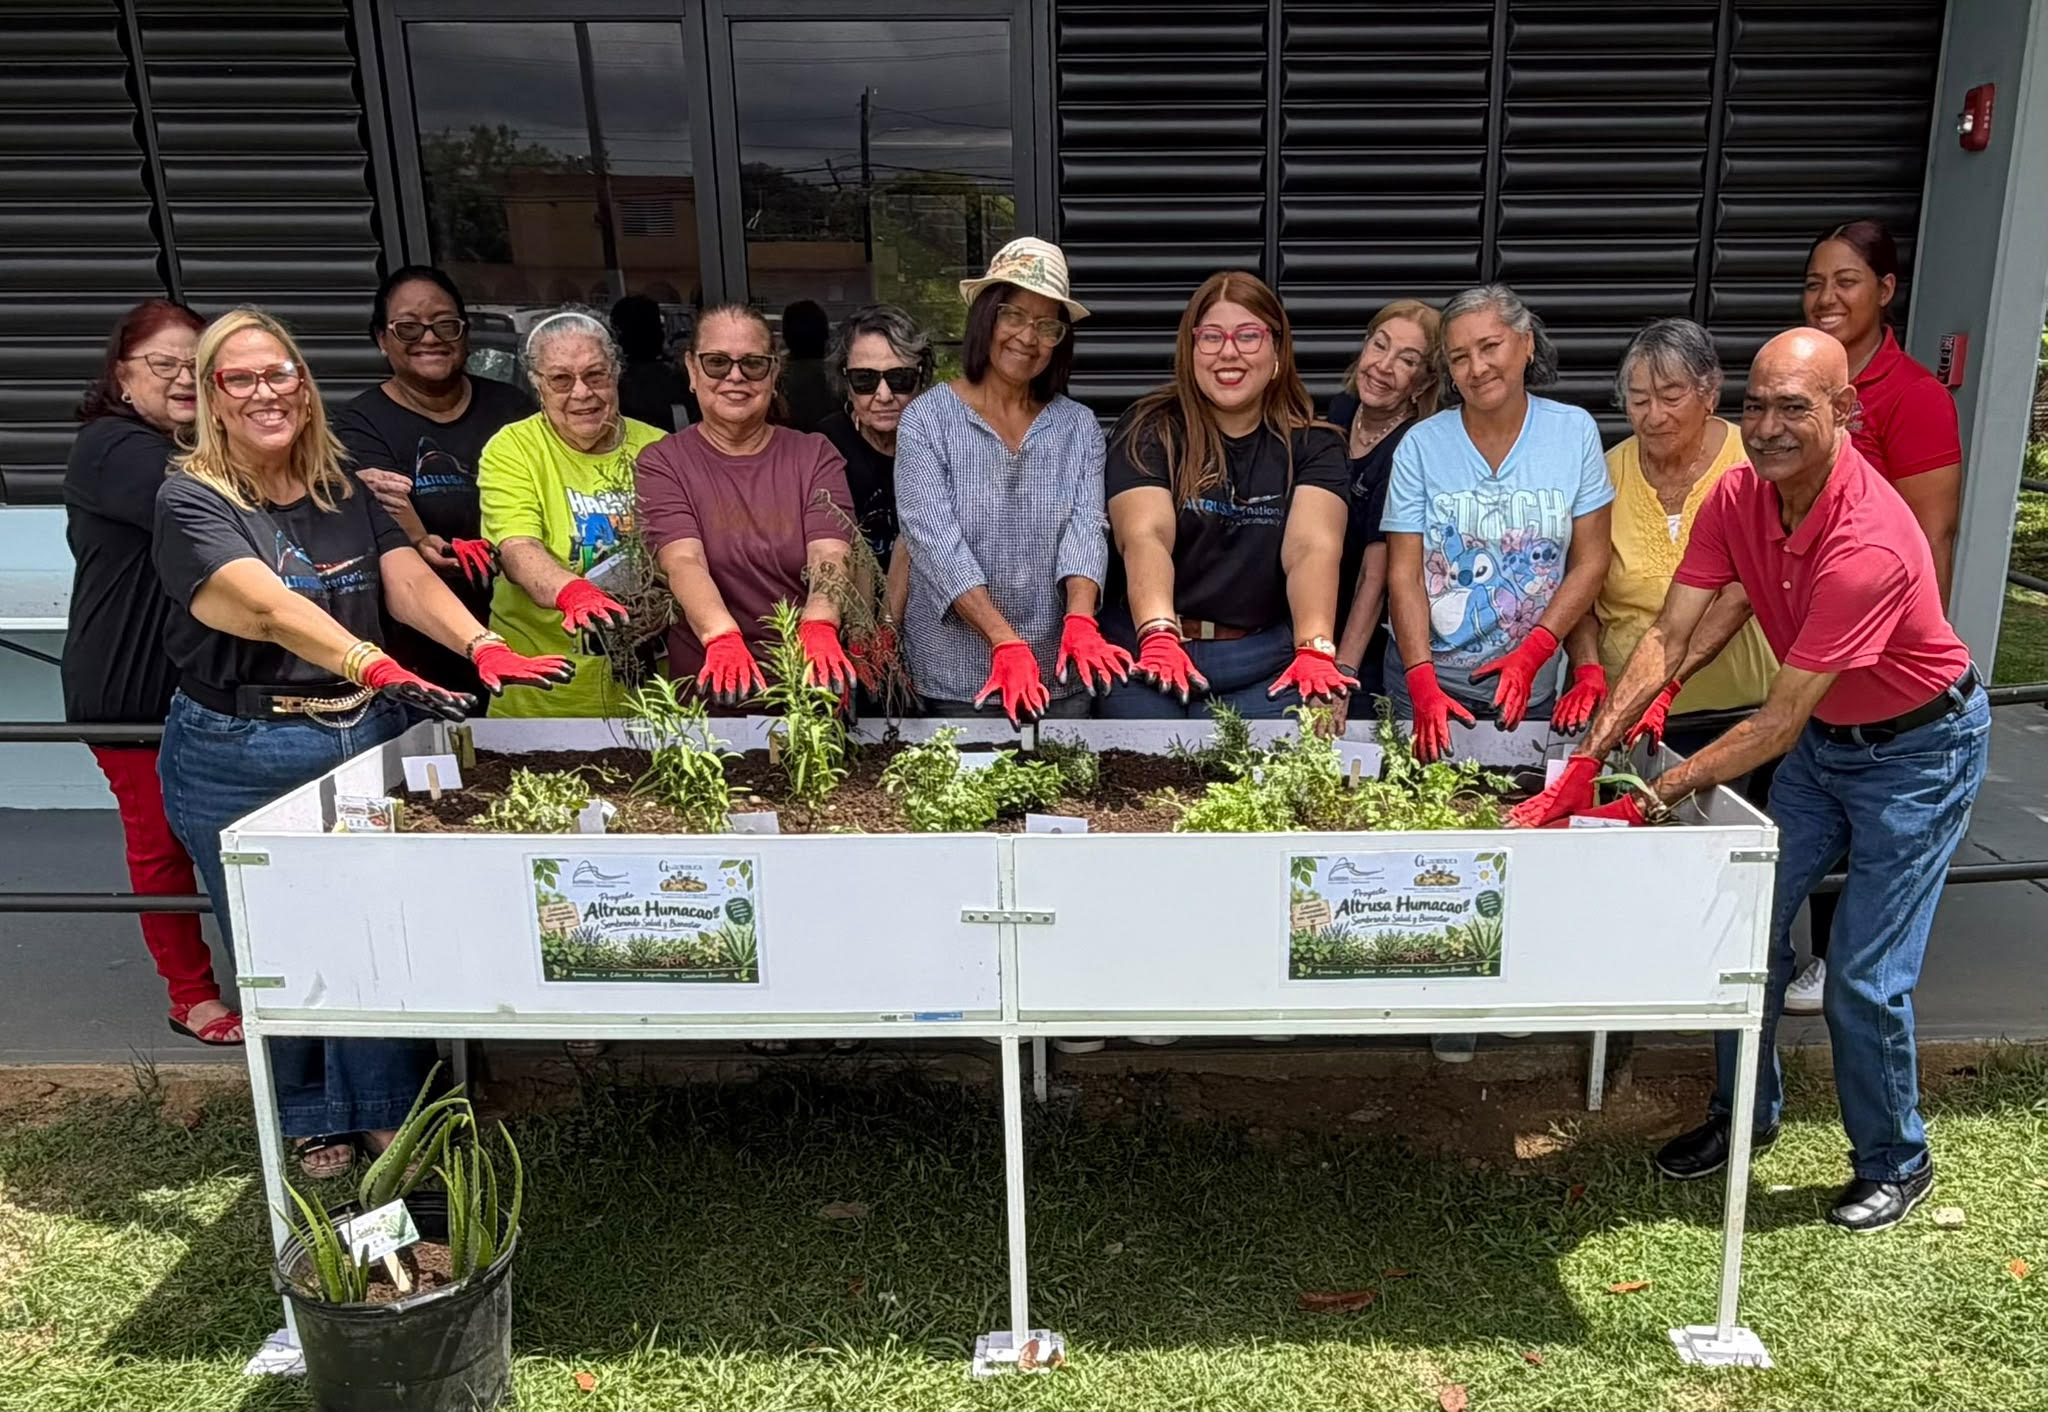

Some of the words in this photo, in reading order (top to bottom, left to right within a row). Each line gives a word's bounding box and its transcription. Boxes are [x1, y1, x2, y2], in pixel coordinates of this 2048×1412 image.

[598, 891, 634, 904] Proyecto
[1352, 887, 1388, 900] Proyecto
[583, 901, 641, 922] Altrusa
[645, 900, 713, 920] Humacao
[1334, 898, 1392, 920] Altrusa
[1396, 896, 1463, 914] Humacao
[641, 918, 661, 927] Salud
[1392, 913, 1411, 923] Salud
